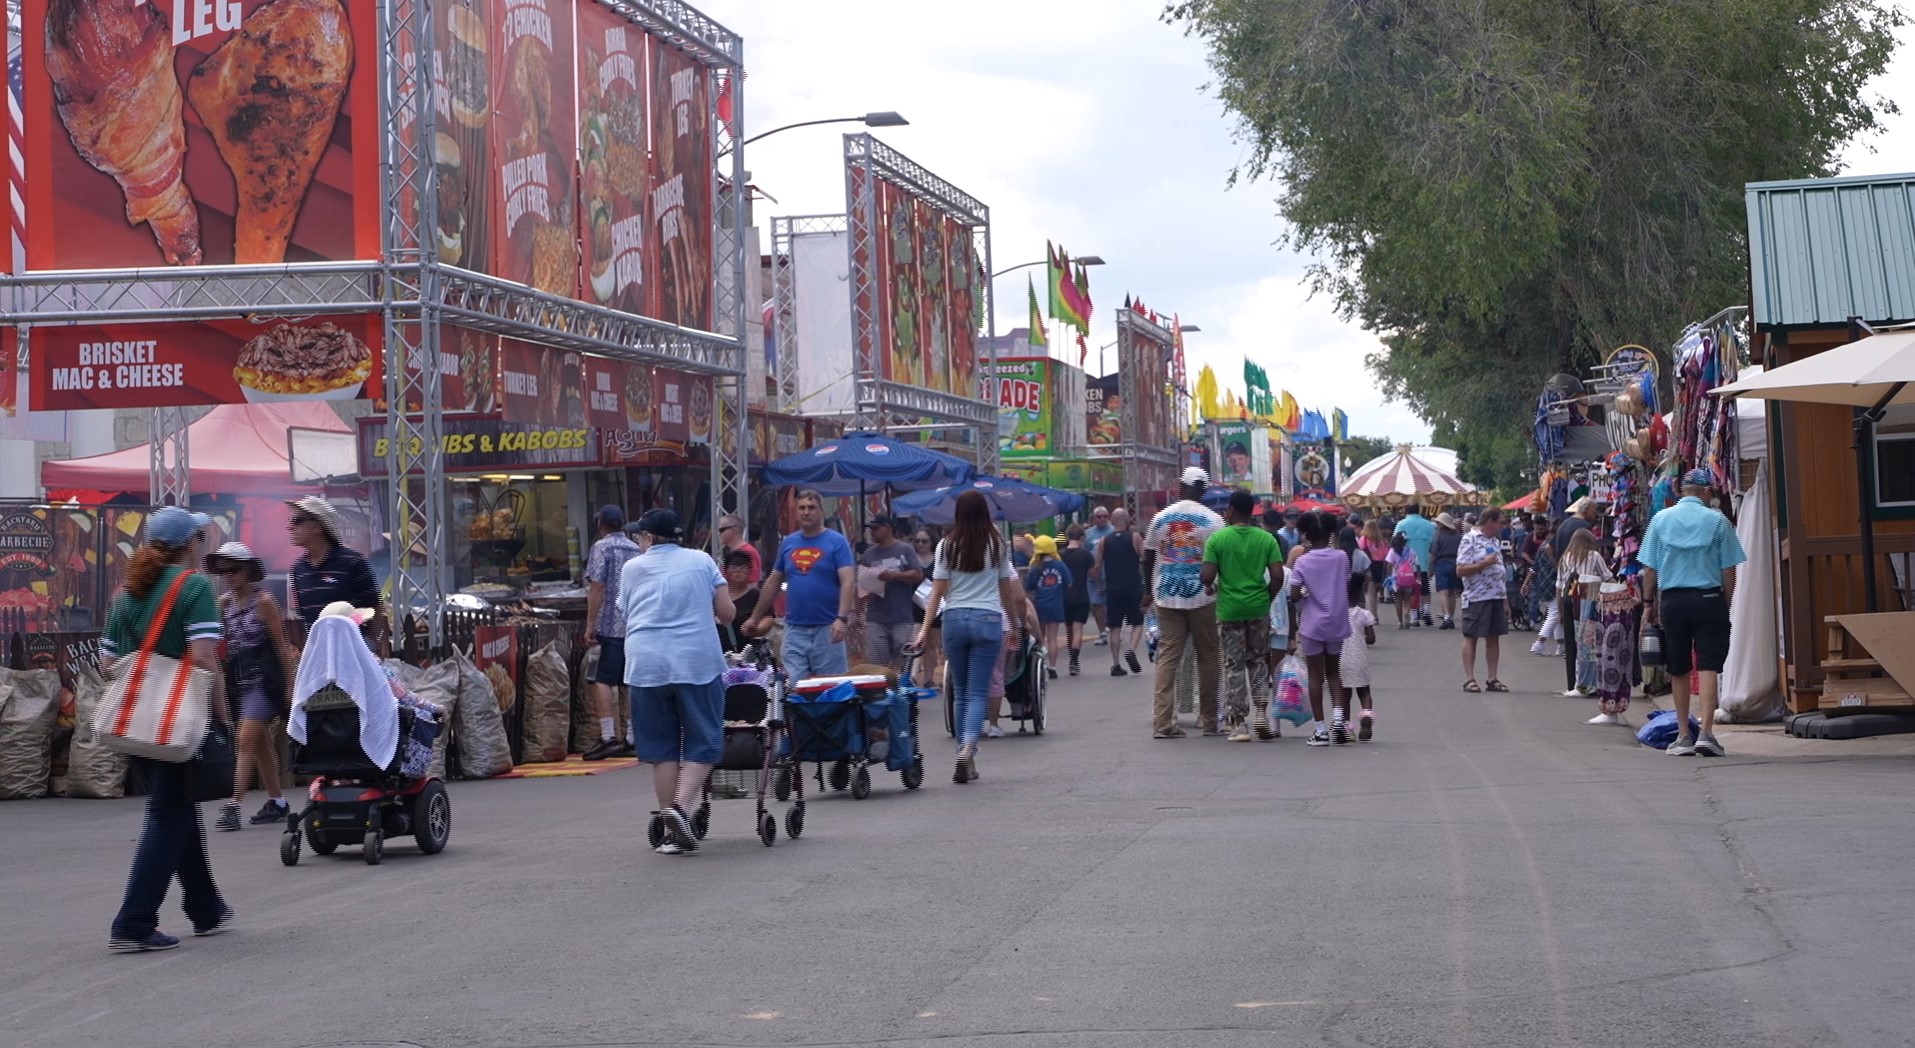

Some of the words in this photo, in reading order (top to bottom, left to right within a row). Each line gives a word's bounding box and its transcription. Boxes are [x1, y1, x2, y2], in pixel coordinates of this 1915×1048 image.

[172, 0, 242, 47] LEG
[514, 7, 553, 54] CHICKEN
[502, 158, 527, 202] PULLED
[526, 152, 549, 188] PORK
[78, 339, 158, 366] BRISKET
[51, 366, 95, 391] MAC
[98, 369, 112, 389] &
[115, 362, 184, 389] CHEESE
[374, 436, 422, 458] BQ
[433, 433, 475, 454] IBS
[480, 435, 494, 453] &
[498, 428, 588, 452] KABOBS
[0, 516, 41, 531] BACKYARD
[0, 536, 49, 548] ARBECUE
[66, 655, 102, 676] WRA
